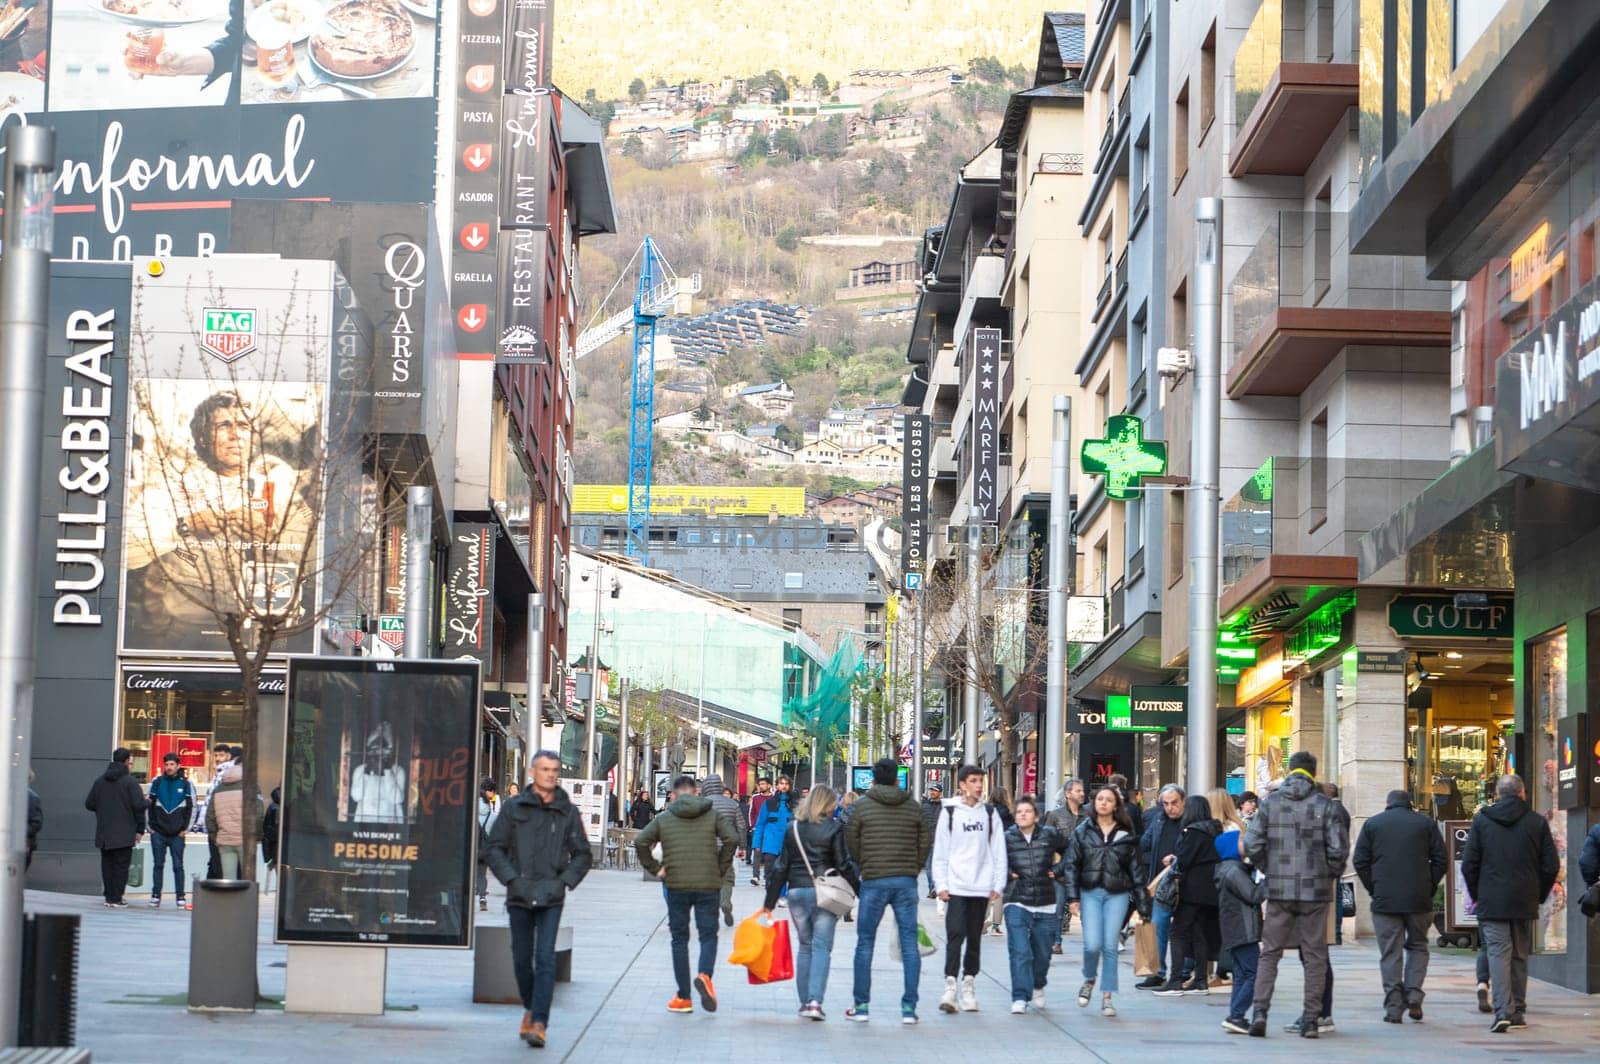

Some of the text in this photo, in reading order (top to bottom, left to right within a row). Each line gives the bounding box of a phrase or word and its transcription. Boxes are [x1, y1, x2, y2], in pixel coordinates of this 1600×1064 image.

[461, 34, 501, 44] PIZZERIA
[506, 27, 549, 149] L'informal
[463, 111, 494, 123] PASTA
[459, 192, 494, 202] ASADOR
[513, 173, 535, 306] RESTAURANT
[454, 272, 493, 282] GRAELLA
[384, 241, 426, 382] QUARS
[207, 312, 252, 331] TAG
[206, 334, 251, 355] HEUER
[53, 308, 115, 615] PULL&BEAR
[978, 398, 996, 518] MARFANY
[909, 419, 923, 569] HOTEL LES CLOSES
[449, 532, 489, 646] L'informal
[382, 618, 405, 630] TA
[1412, 603, 1507, 630] GOLF
[127, 673, 179, 689] Cartier
[1134, 701, 1183, 712] LOTTUSSE
[179, 749, 203, 757] Cartier
[333, 842, 419, 861] PERSONÆ
